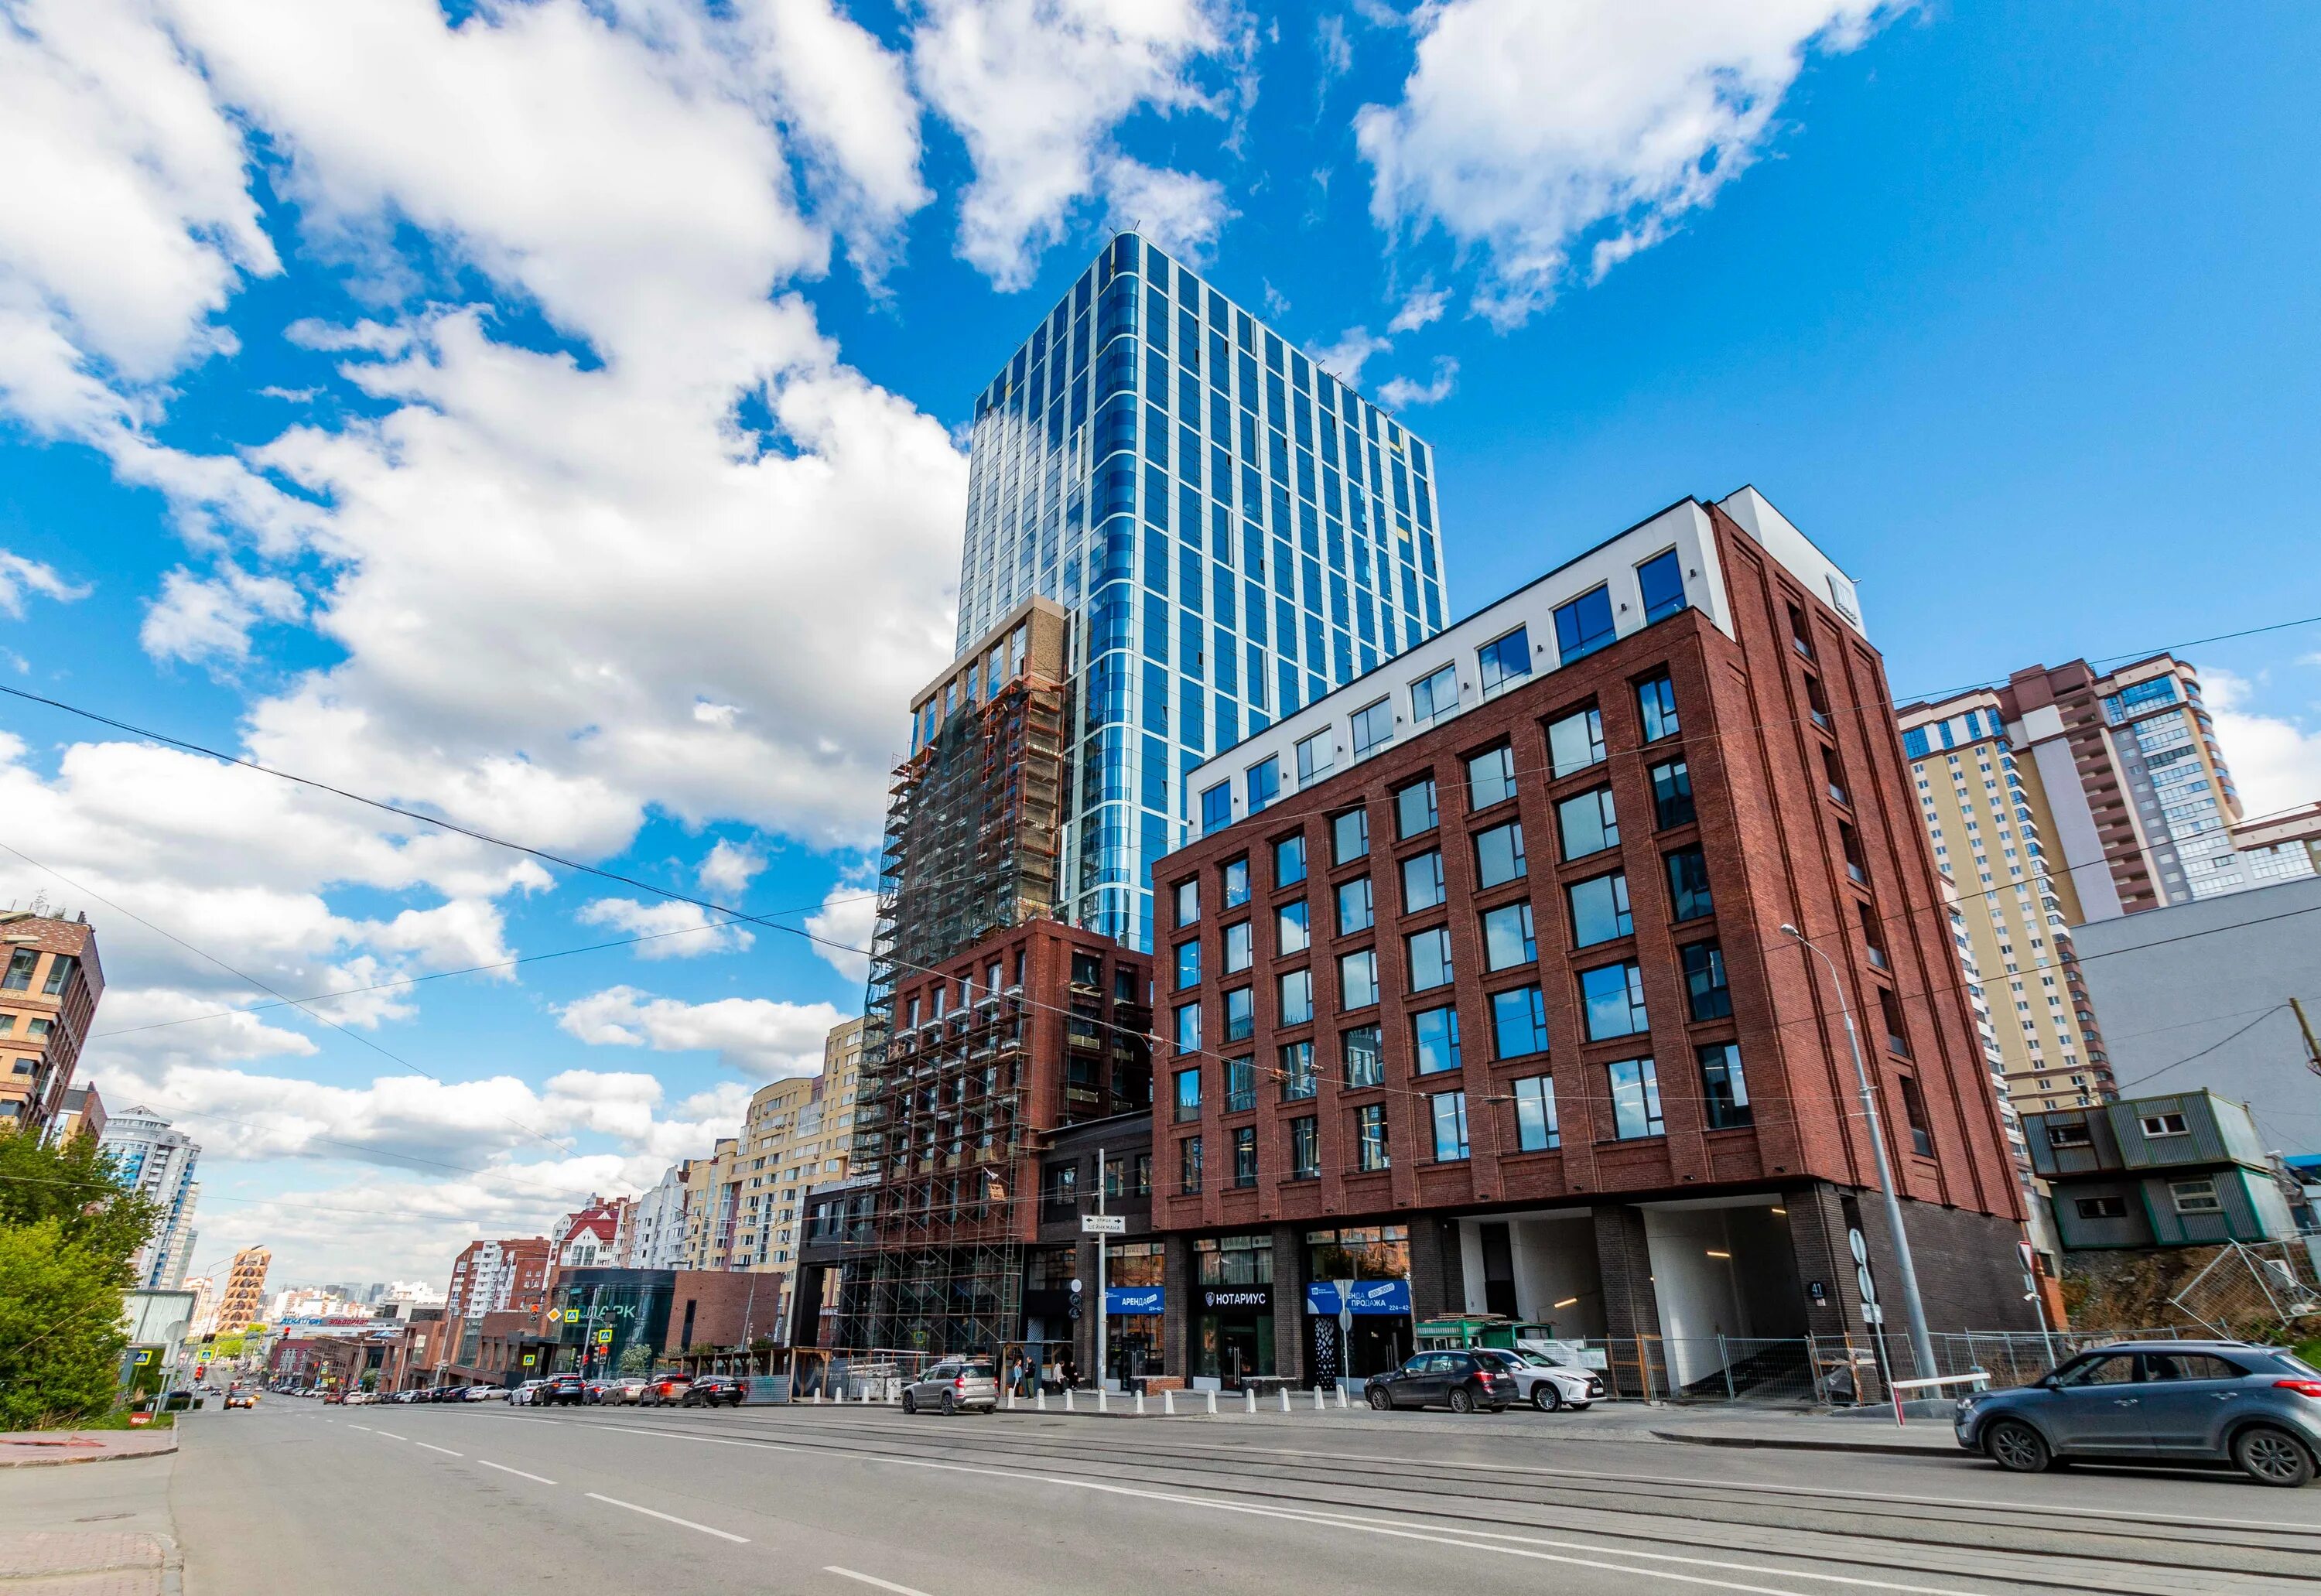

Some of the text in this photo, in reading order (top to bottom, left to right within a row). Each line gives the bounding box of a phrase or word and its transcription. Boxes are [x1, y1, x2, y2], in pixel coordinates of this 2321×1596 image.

[1812, 1283, 1822, 1294] 41
[1122, 1297, 1147, 1307] АРЕНДА
[1216, 1293, 1266, 1304] НОТАРИУС
[1351, 1299, 1386, 1307] ПРОДАЖА
